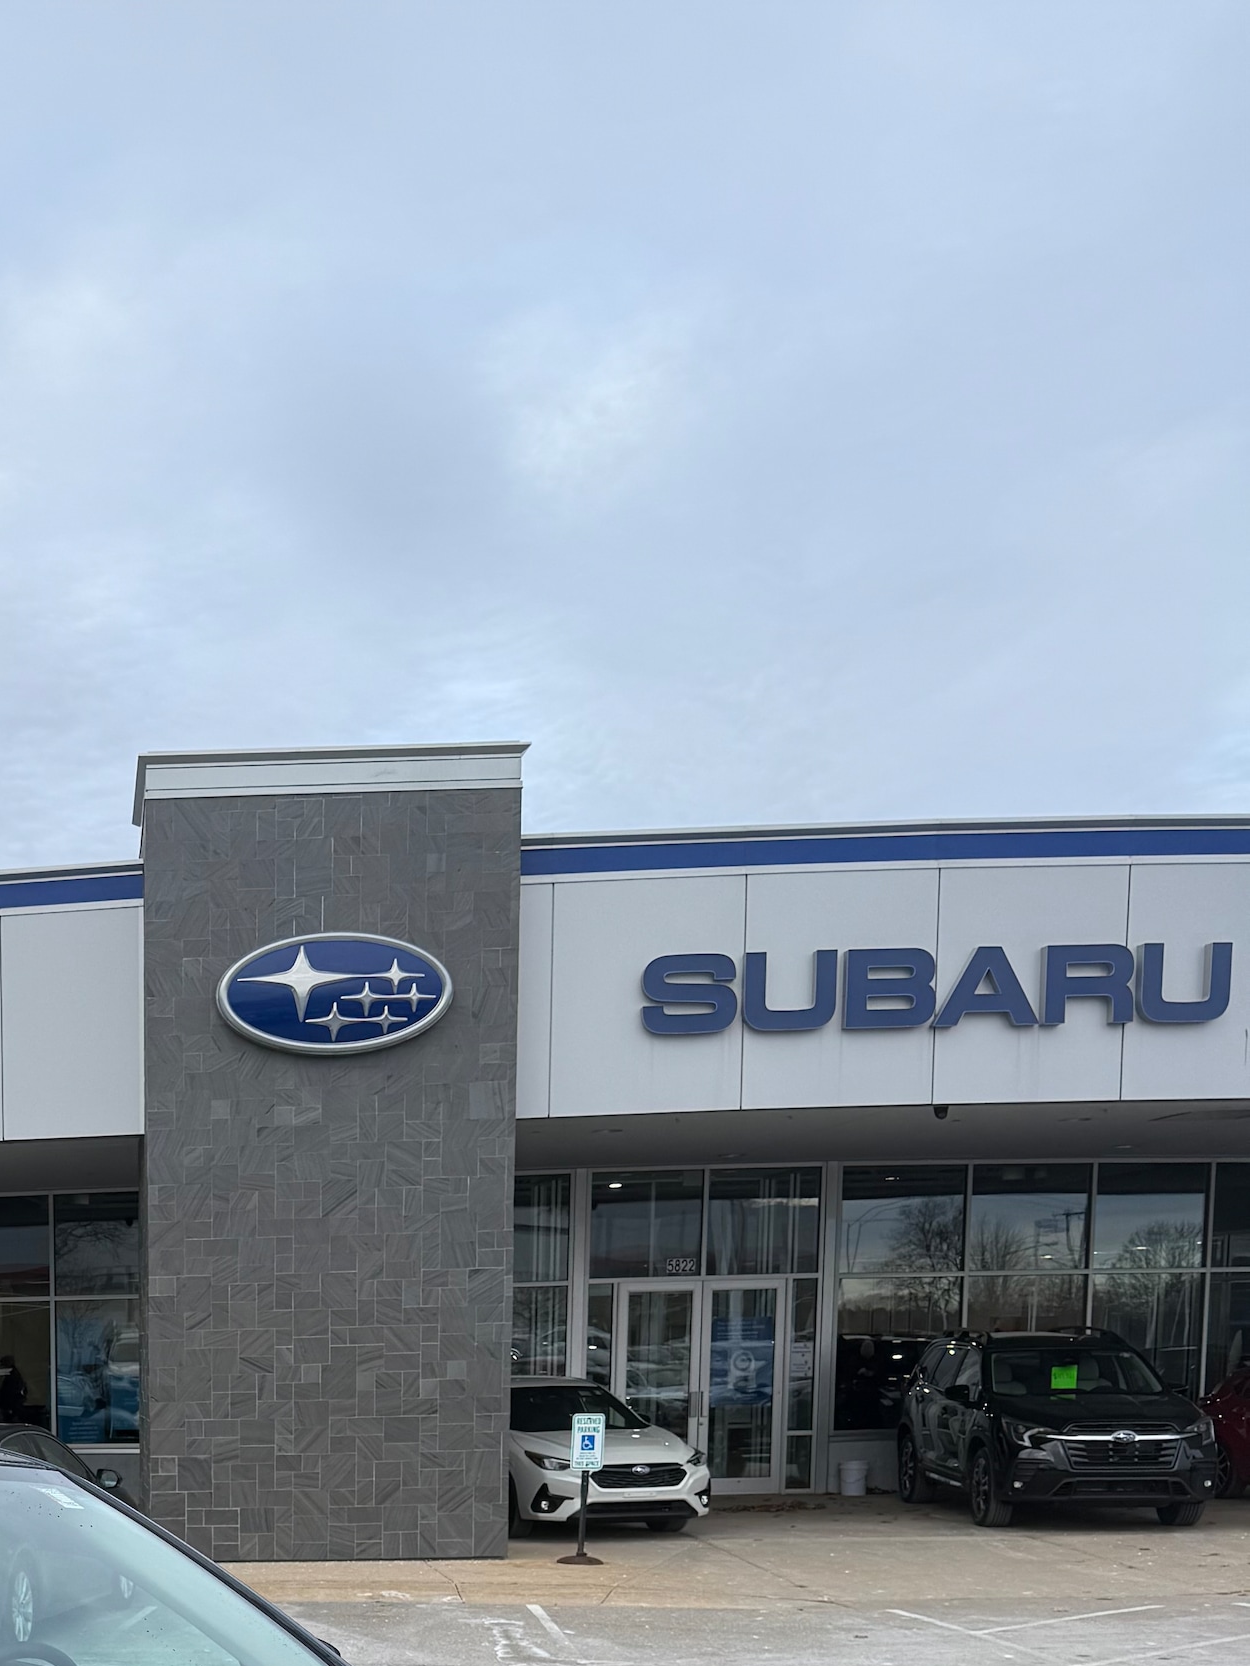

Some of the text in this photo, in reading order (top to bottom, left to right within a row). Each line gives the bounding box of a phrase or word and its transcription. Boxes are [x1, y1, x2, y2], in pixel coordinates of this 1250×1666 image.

[641, 942, 1233, 1035] SUBARU
[667, 1259, 695, 1272] 5822
[577, 1417, 601, 1425] RESERVED
